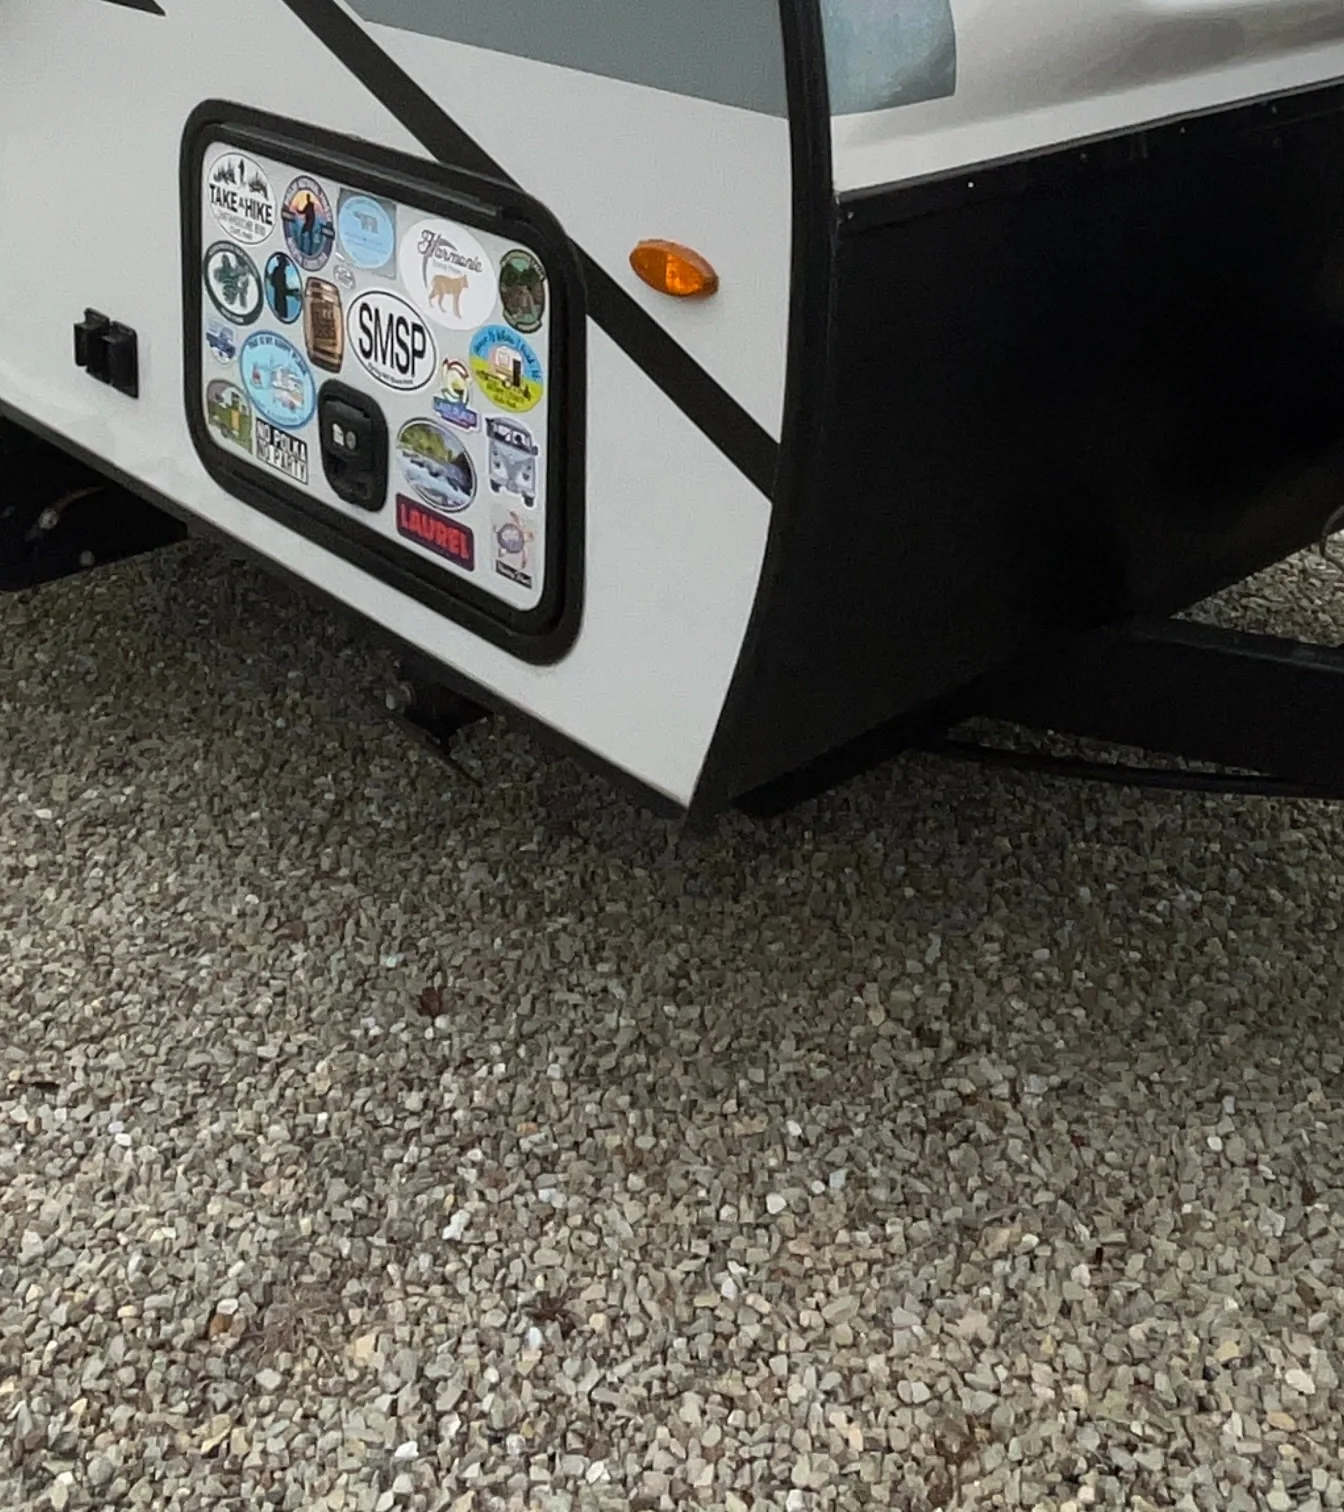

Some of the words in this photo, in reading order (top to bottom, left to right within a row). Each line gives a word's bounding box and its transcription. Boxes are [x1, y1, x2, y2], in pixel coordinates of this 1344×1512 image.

[209, 183, 238, 213] TAKE
[245, 196, 273, 226] HIKE
[358, 302, 427, 379] SMSP
[400, 502, 470, 560] LAUREL
